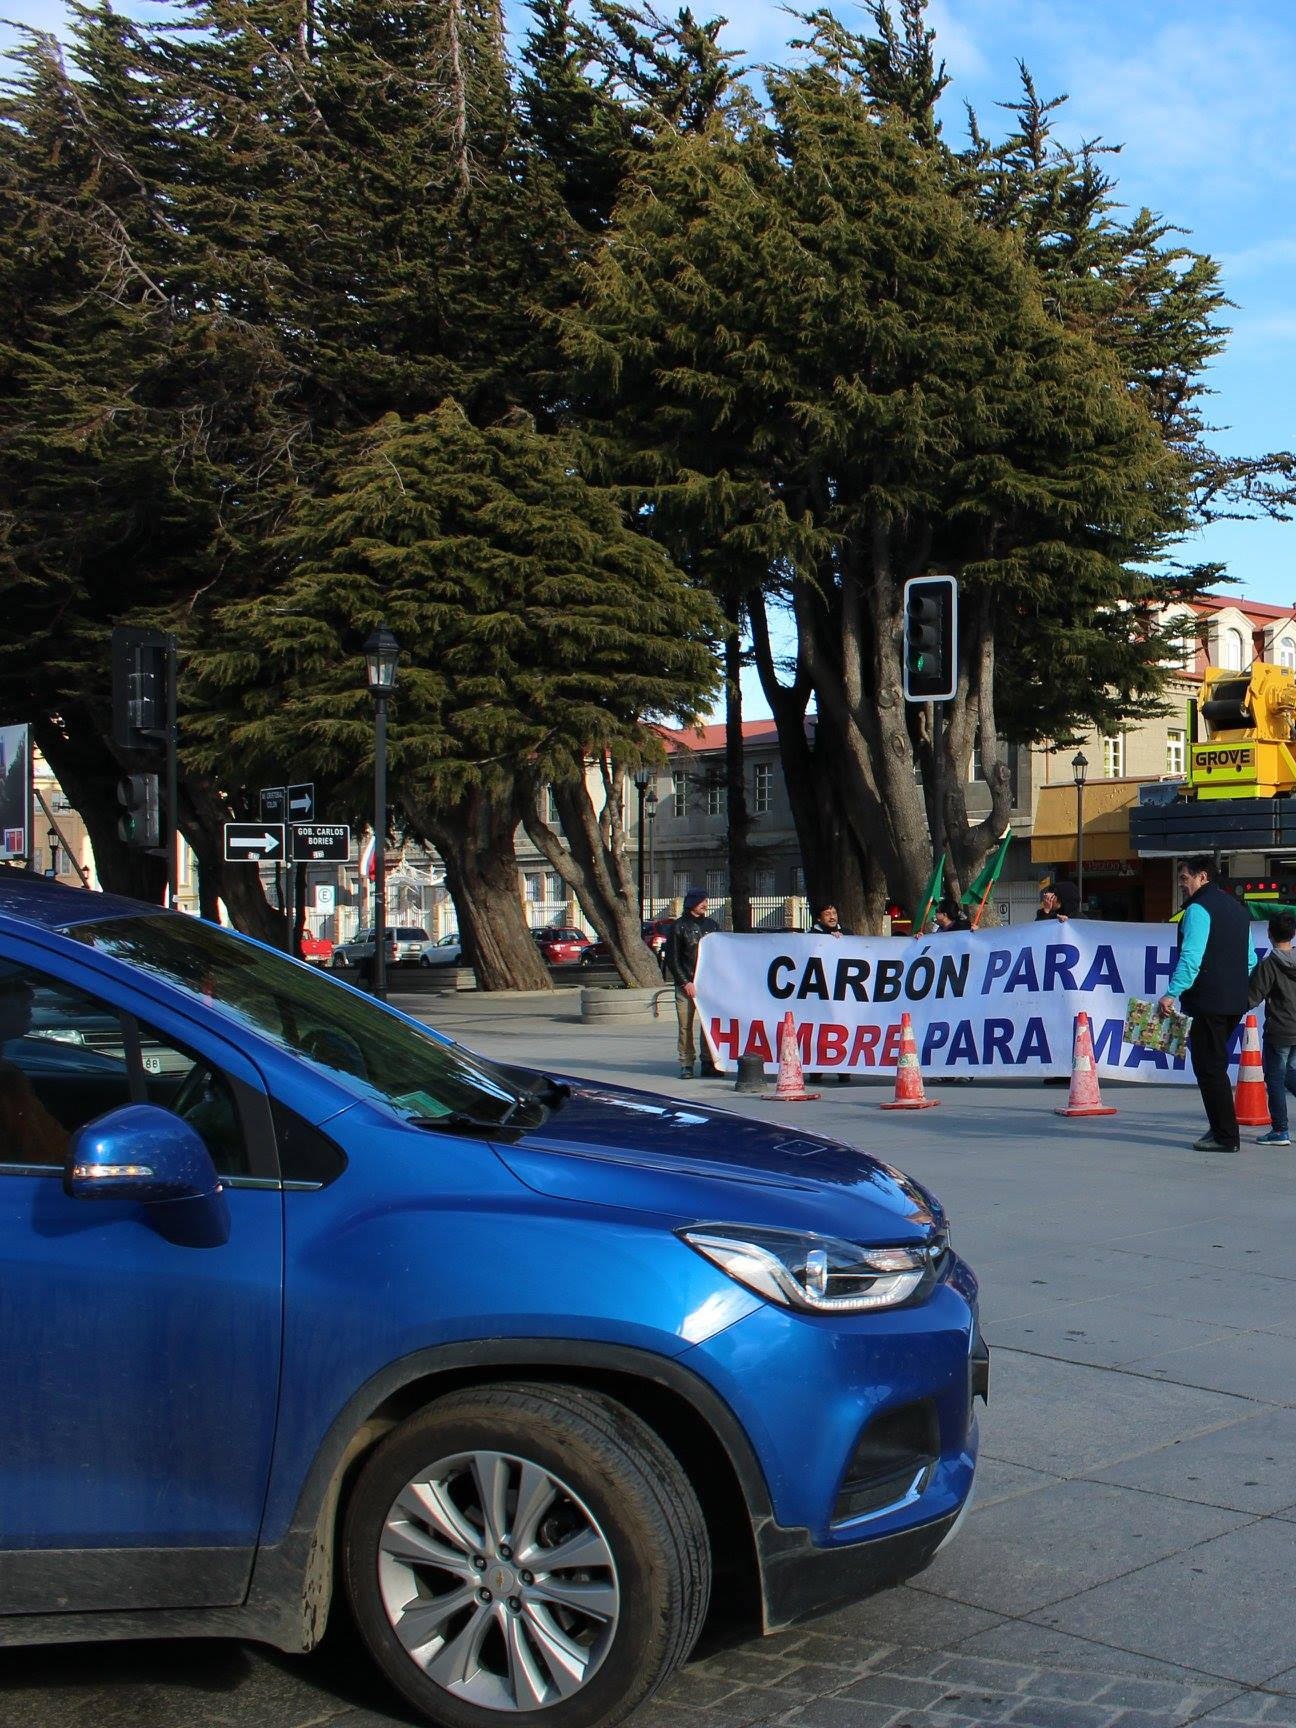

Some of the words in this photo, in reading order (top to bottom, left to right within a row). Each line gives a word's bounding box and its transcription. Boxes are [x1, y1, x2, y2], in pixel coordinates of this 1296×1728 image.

[1196, 749, 1251, 766] GROVE
[297, 828, 315, 836] GOB.
[316, 828, 344, 836] CARLOS
[308, 837, 334, 845] BORIES
[767, 945, 970, 1003] CARBÓN
[981, 944, 1125, 995] PARA
[711, 1017, 903, 1067] HAMBRE
[922, 1017, 1052, 1066] PARA
